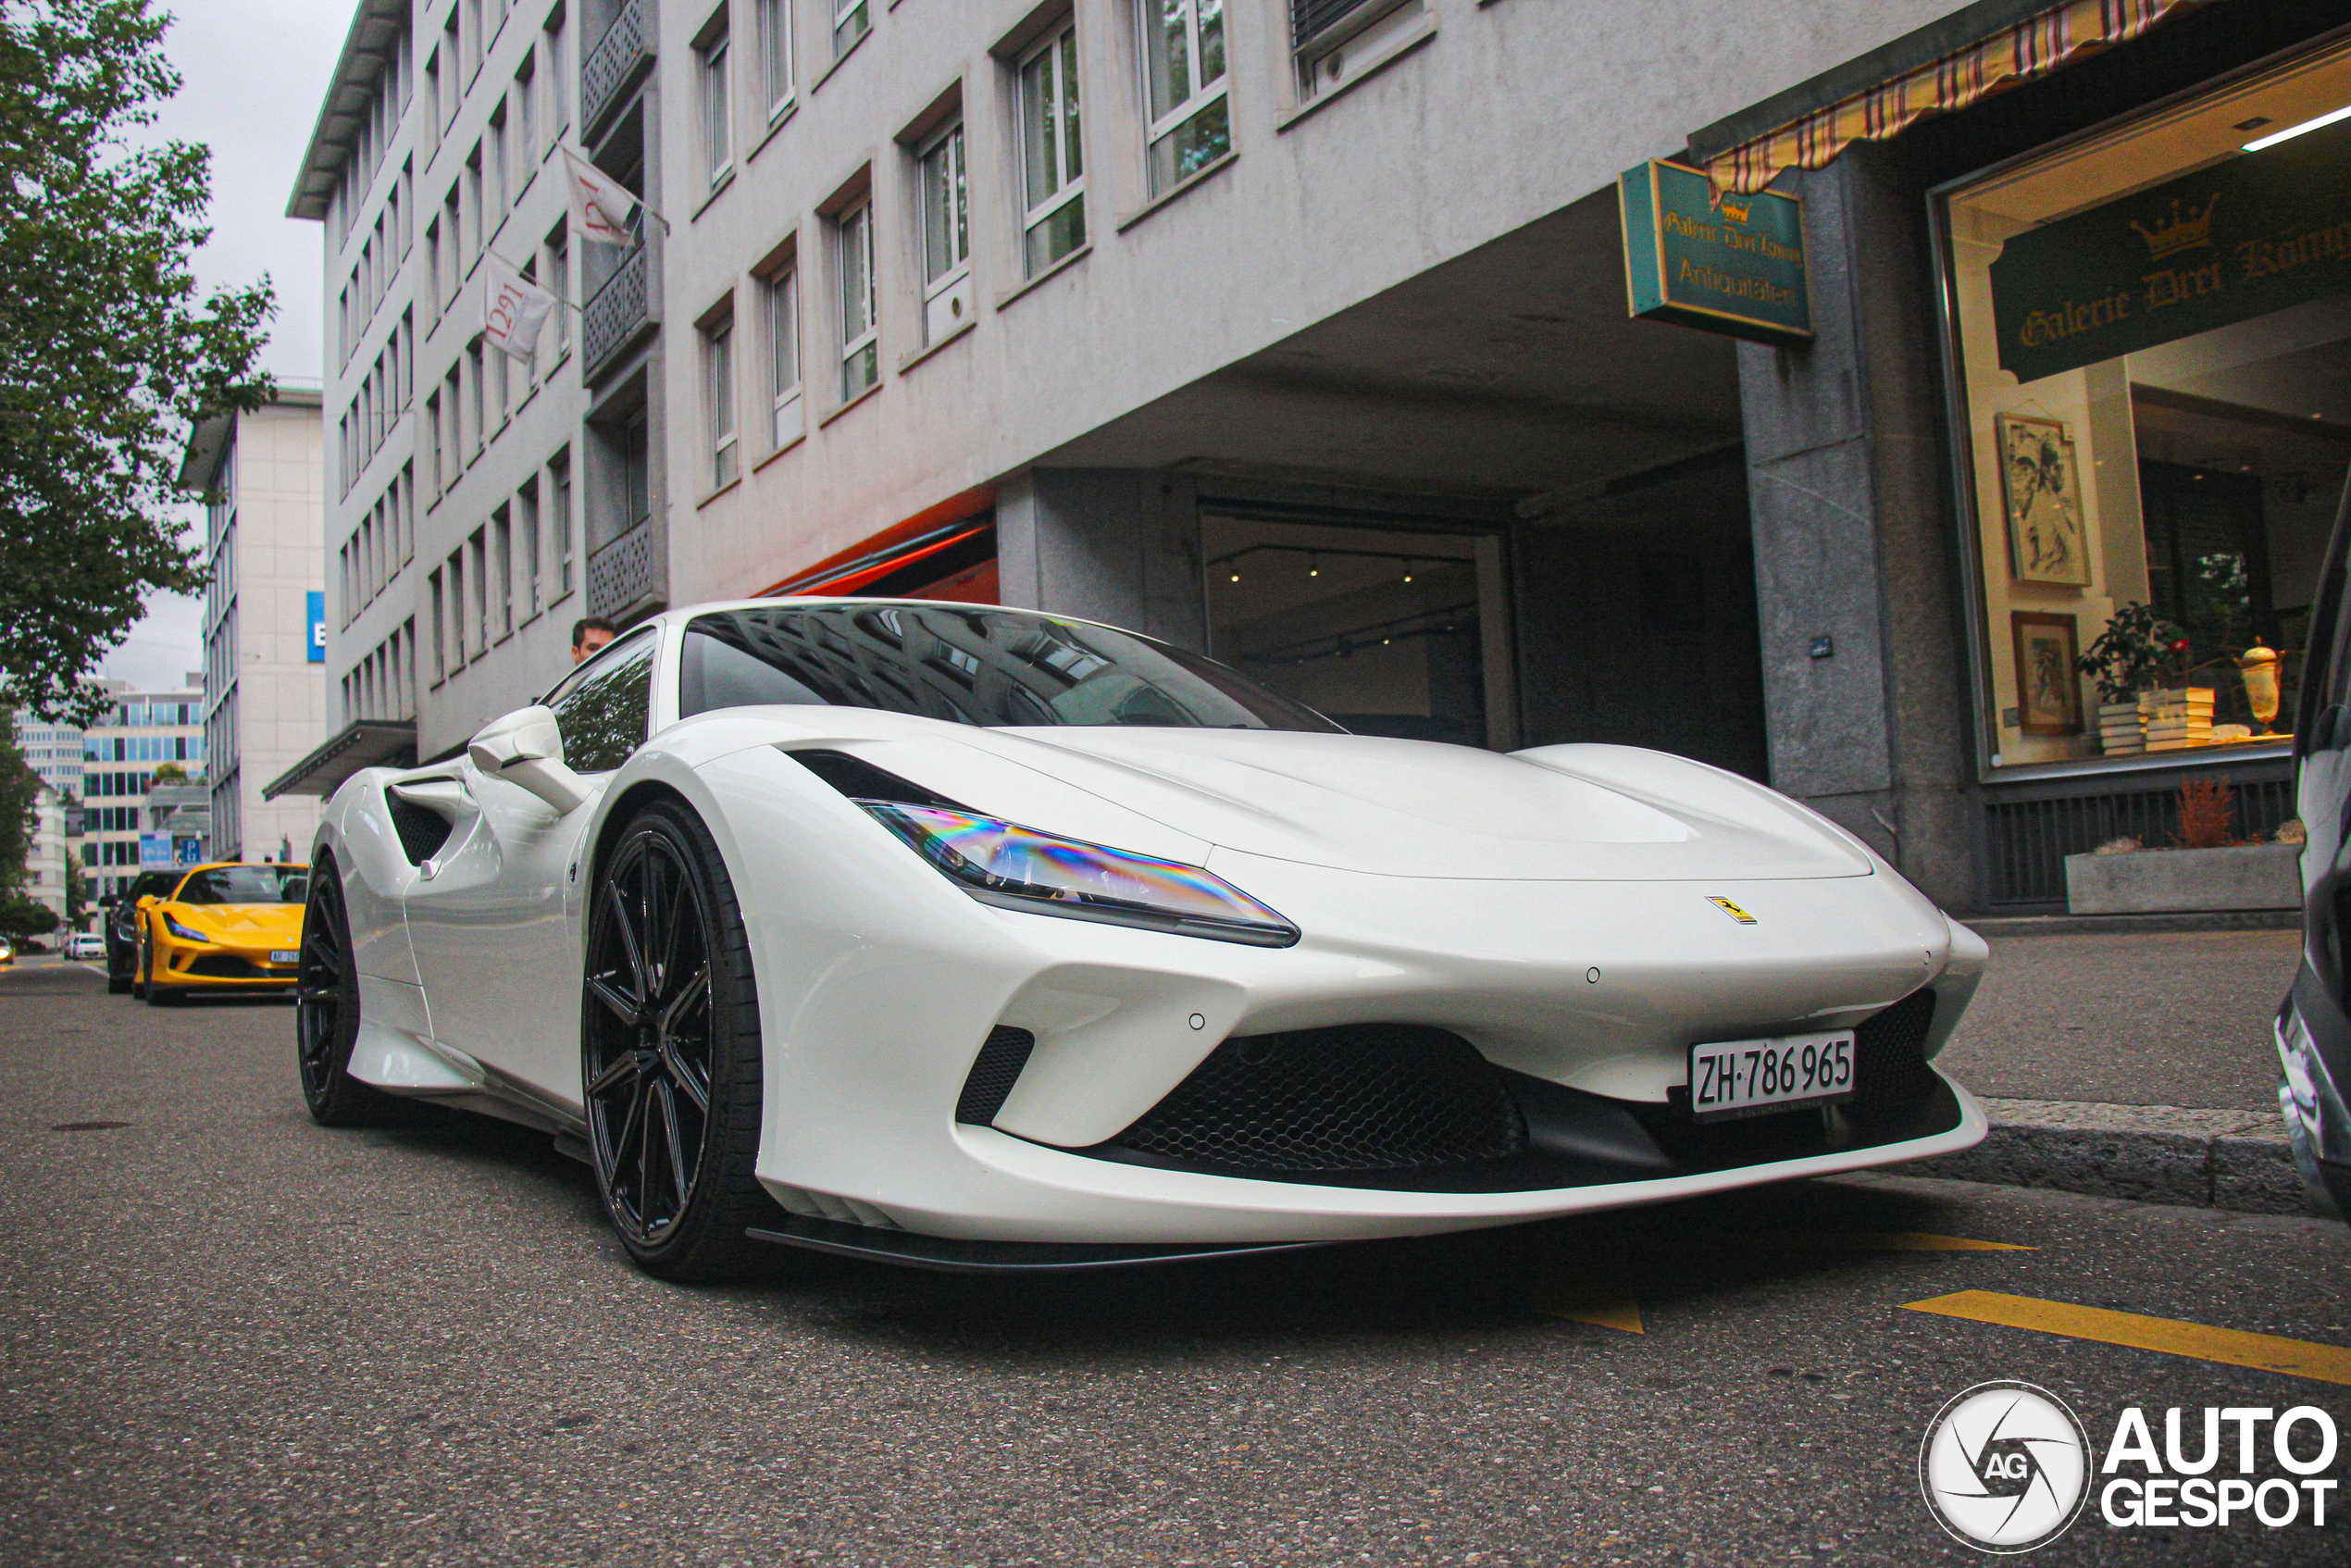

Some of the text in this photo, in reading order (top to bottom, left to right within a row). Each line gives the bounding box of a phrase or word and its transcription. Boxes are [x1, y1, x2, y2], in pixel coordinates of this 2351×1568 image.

[1680, 258, 1797, 305] Antiquitäten
[2021, 286, 2132, 348] Galerie
[2142, 252, 2225, 311] Drei
